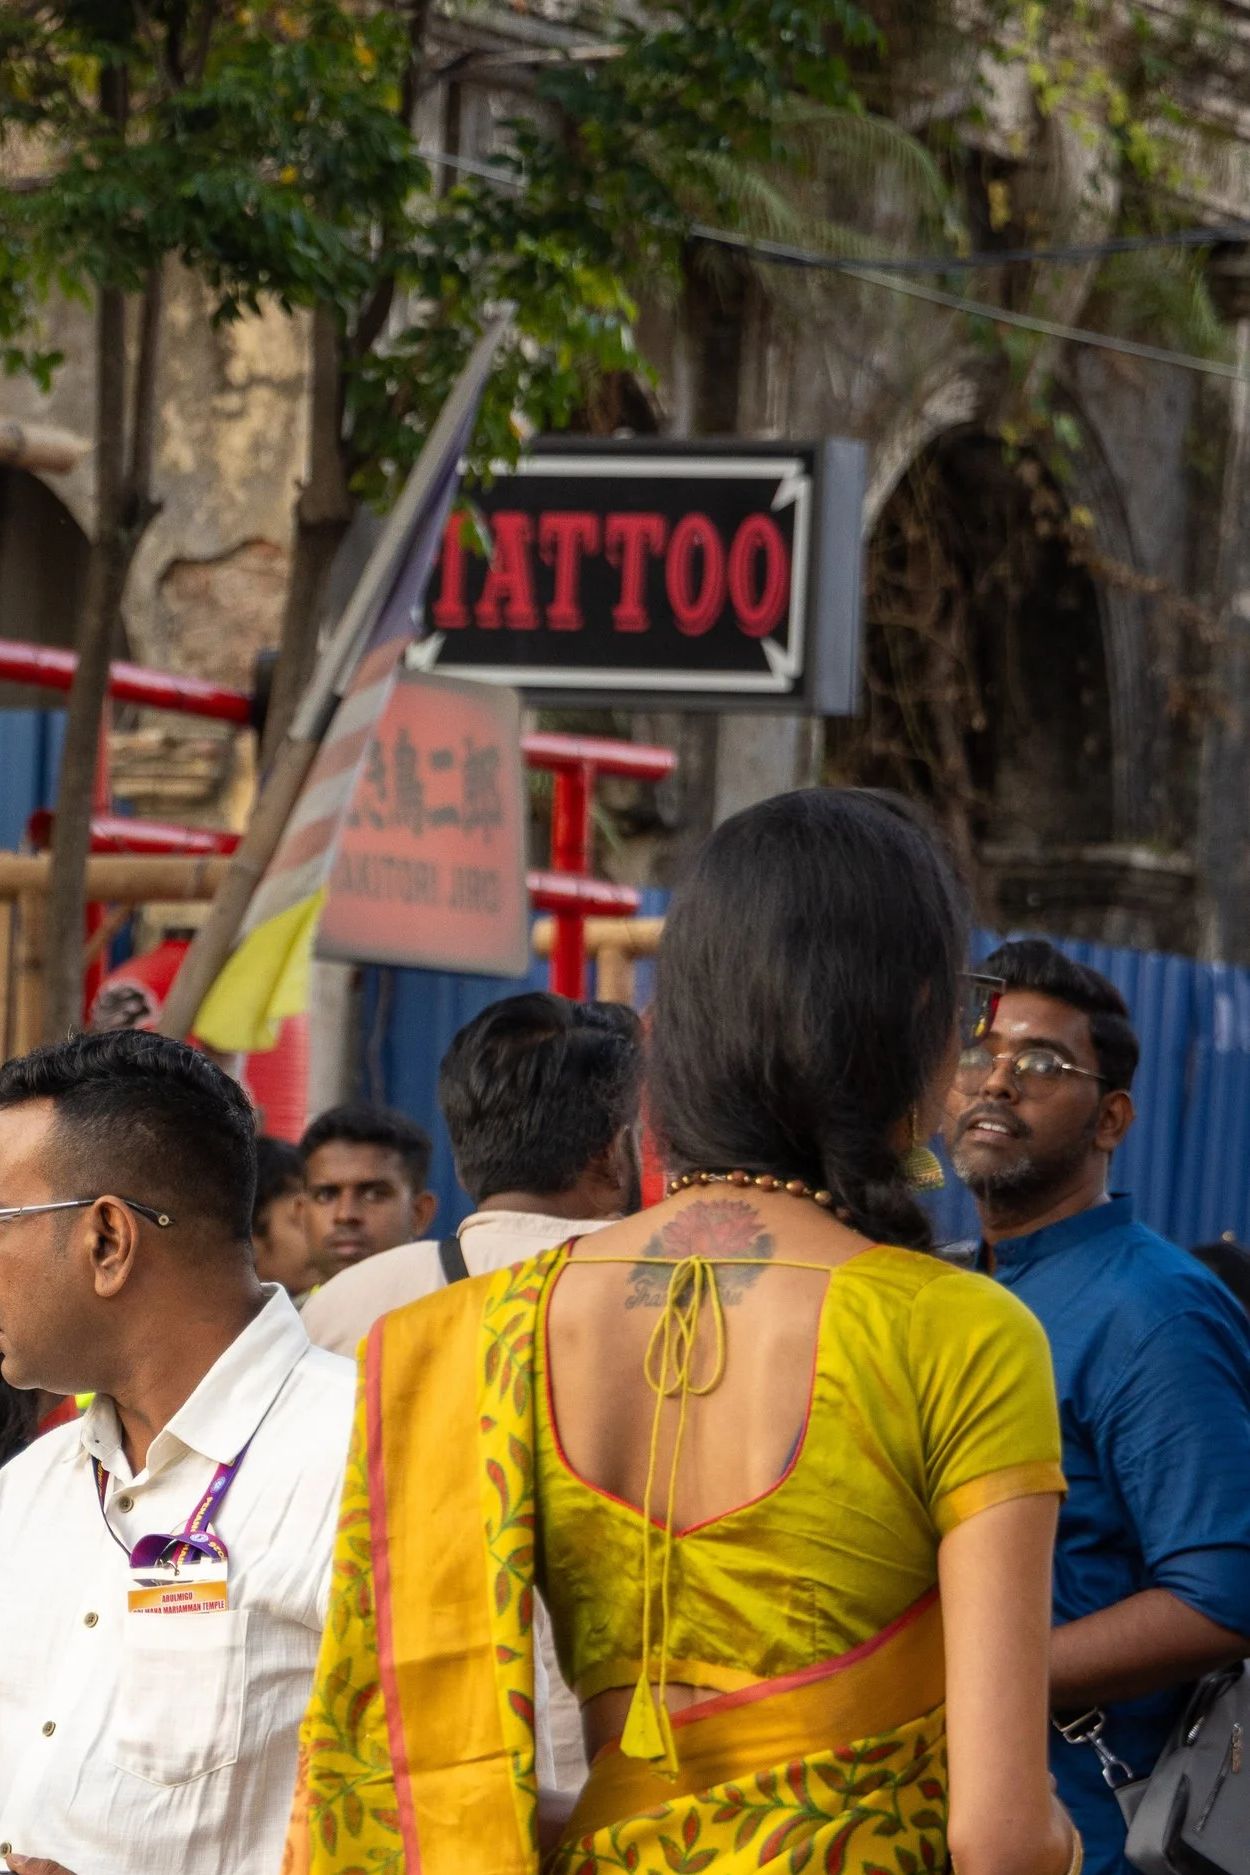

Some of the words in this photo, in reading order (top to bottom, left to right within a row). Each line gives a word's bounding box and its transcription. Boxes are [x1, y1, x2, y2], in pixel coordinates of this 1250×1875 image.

[432, 511, 789, 638] TATTOO
[332, 851, 437, 905] AKITORI
[161, 1592, 193, 1603] ARULMIGU
[162, 1603, 202, 1614] MARIAMMAN
[202, 1600, 225, 1610] TEMPLE
